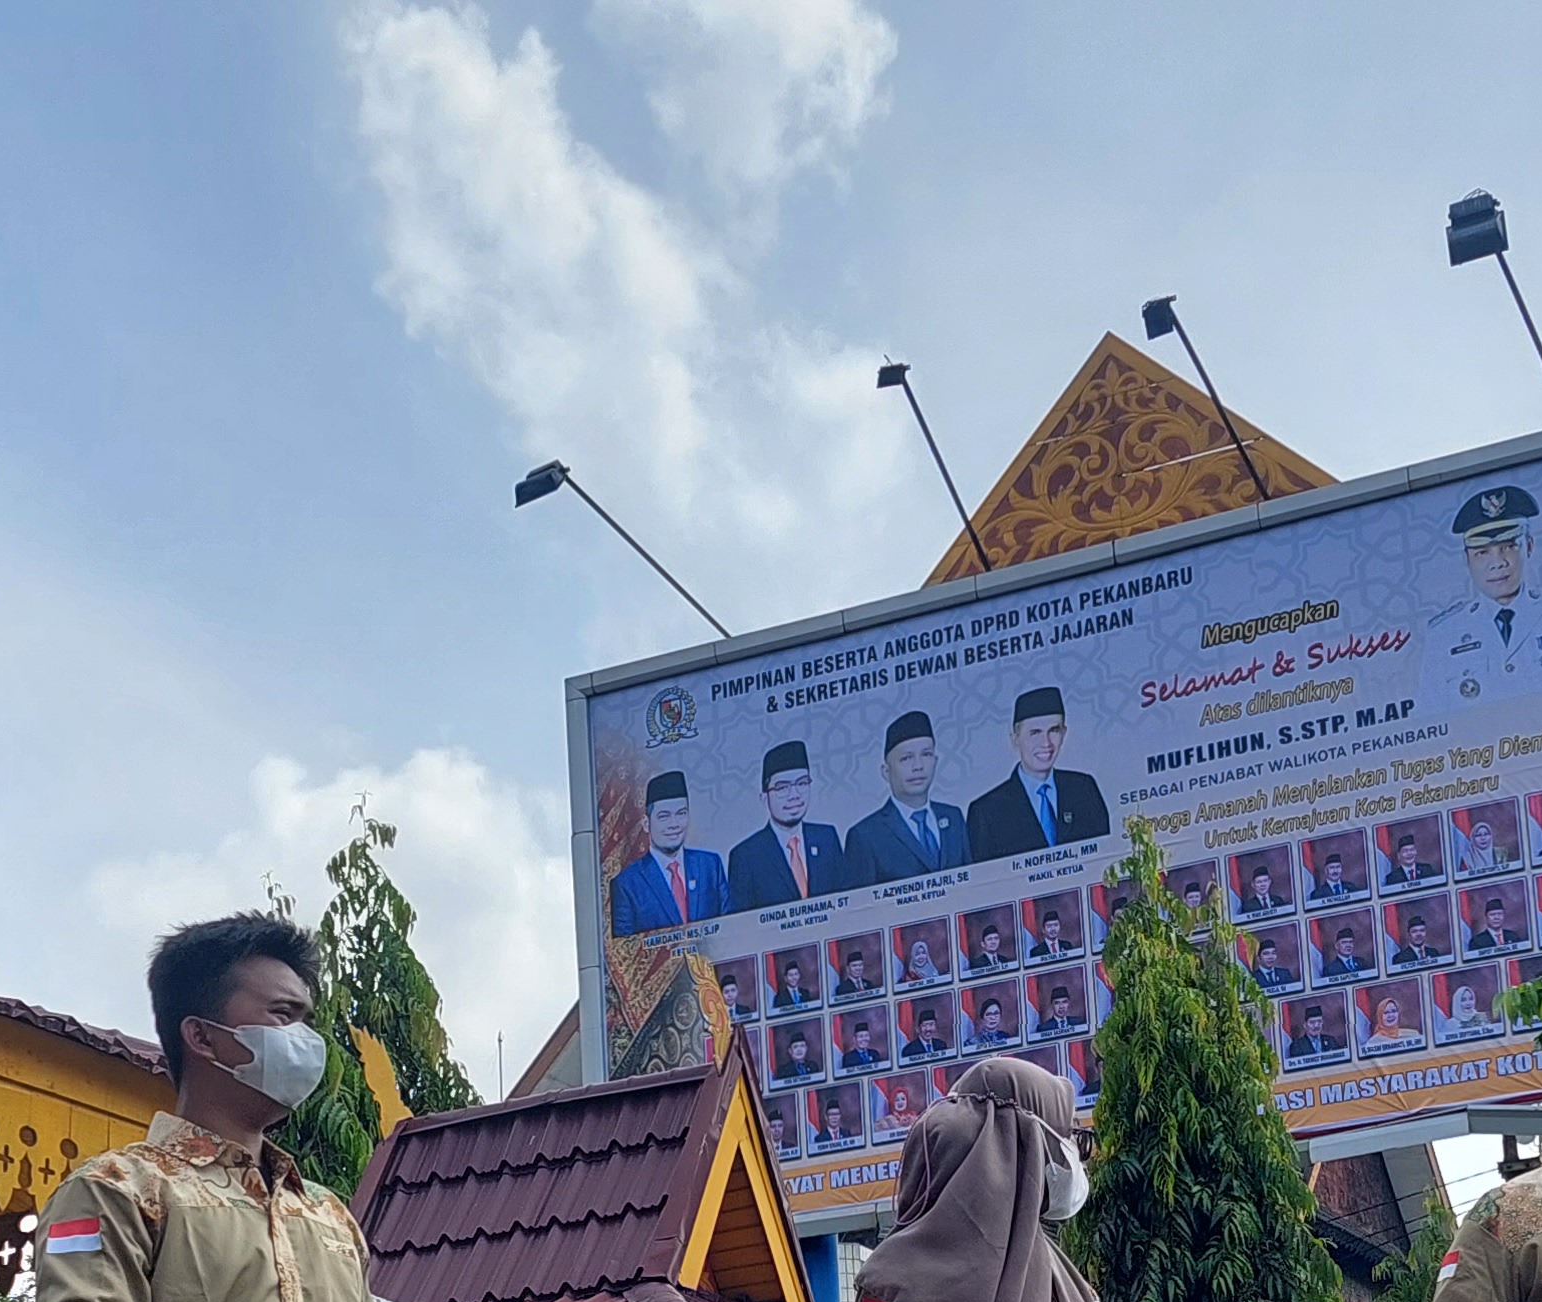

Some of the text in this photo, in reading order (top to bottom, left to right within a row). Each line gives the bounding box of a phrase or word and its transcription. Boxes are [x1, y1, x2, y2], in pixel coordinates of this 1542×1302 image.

[711, 566, 1193, 701] PIMPINAN BESERTA ANGGOTA DPRD KOTA PEKANBARU
[1201, 600, 1339, 649] Mengucapkan
[766, 608, 1134, 713] & SEKRETARIS DEWAN BESERTA JAJARAN
[1141, 630, 1411, 708] Selamat & Sukses
[1200, 676, 1354, 727] Atas dilantiknya
[1147, 699, 1415, 774] MUFLIHUN, S.STP, M.AP
[1119, 723, 1449, 805] SEBAGAI PENJABAT WALIKOTA PEKANBARU
[1195, 791, 1268, 823] Amanah
[1272, 767, 1388, 807] Menjalankan
[1391, 755, 1445, 782] Tugas
[1448, 744, 1493, 771] Yang
[1204, 774, 1499, 849] Untuk Kemajuan Kota Pekanbaru
[1024, 848, 1078, 868] NOFRIZAL,
[1081, 843, 1098, 856] MM
[1028, 864, 1084, 883] WAKIL KETUA
[882, 880, 925, 899] AZWENDI
[957, 871, 970, 883] SE
[921, 888, 947, 901] KETUA
[760, 896, 849, 924] GINDA BURNAMA, ST
[804, 914, 828, 926] KETUA
[1319, 1058, 1492, 1106] MASYARAKAT
[785, 1171, 826, 1196] YAT
